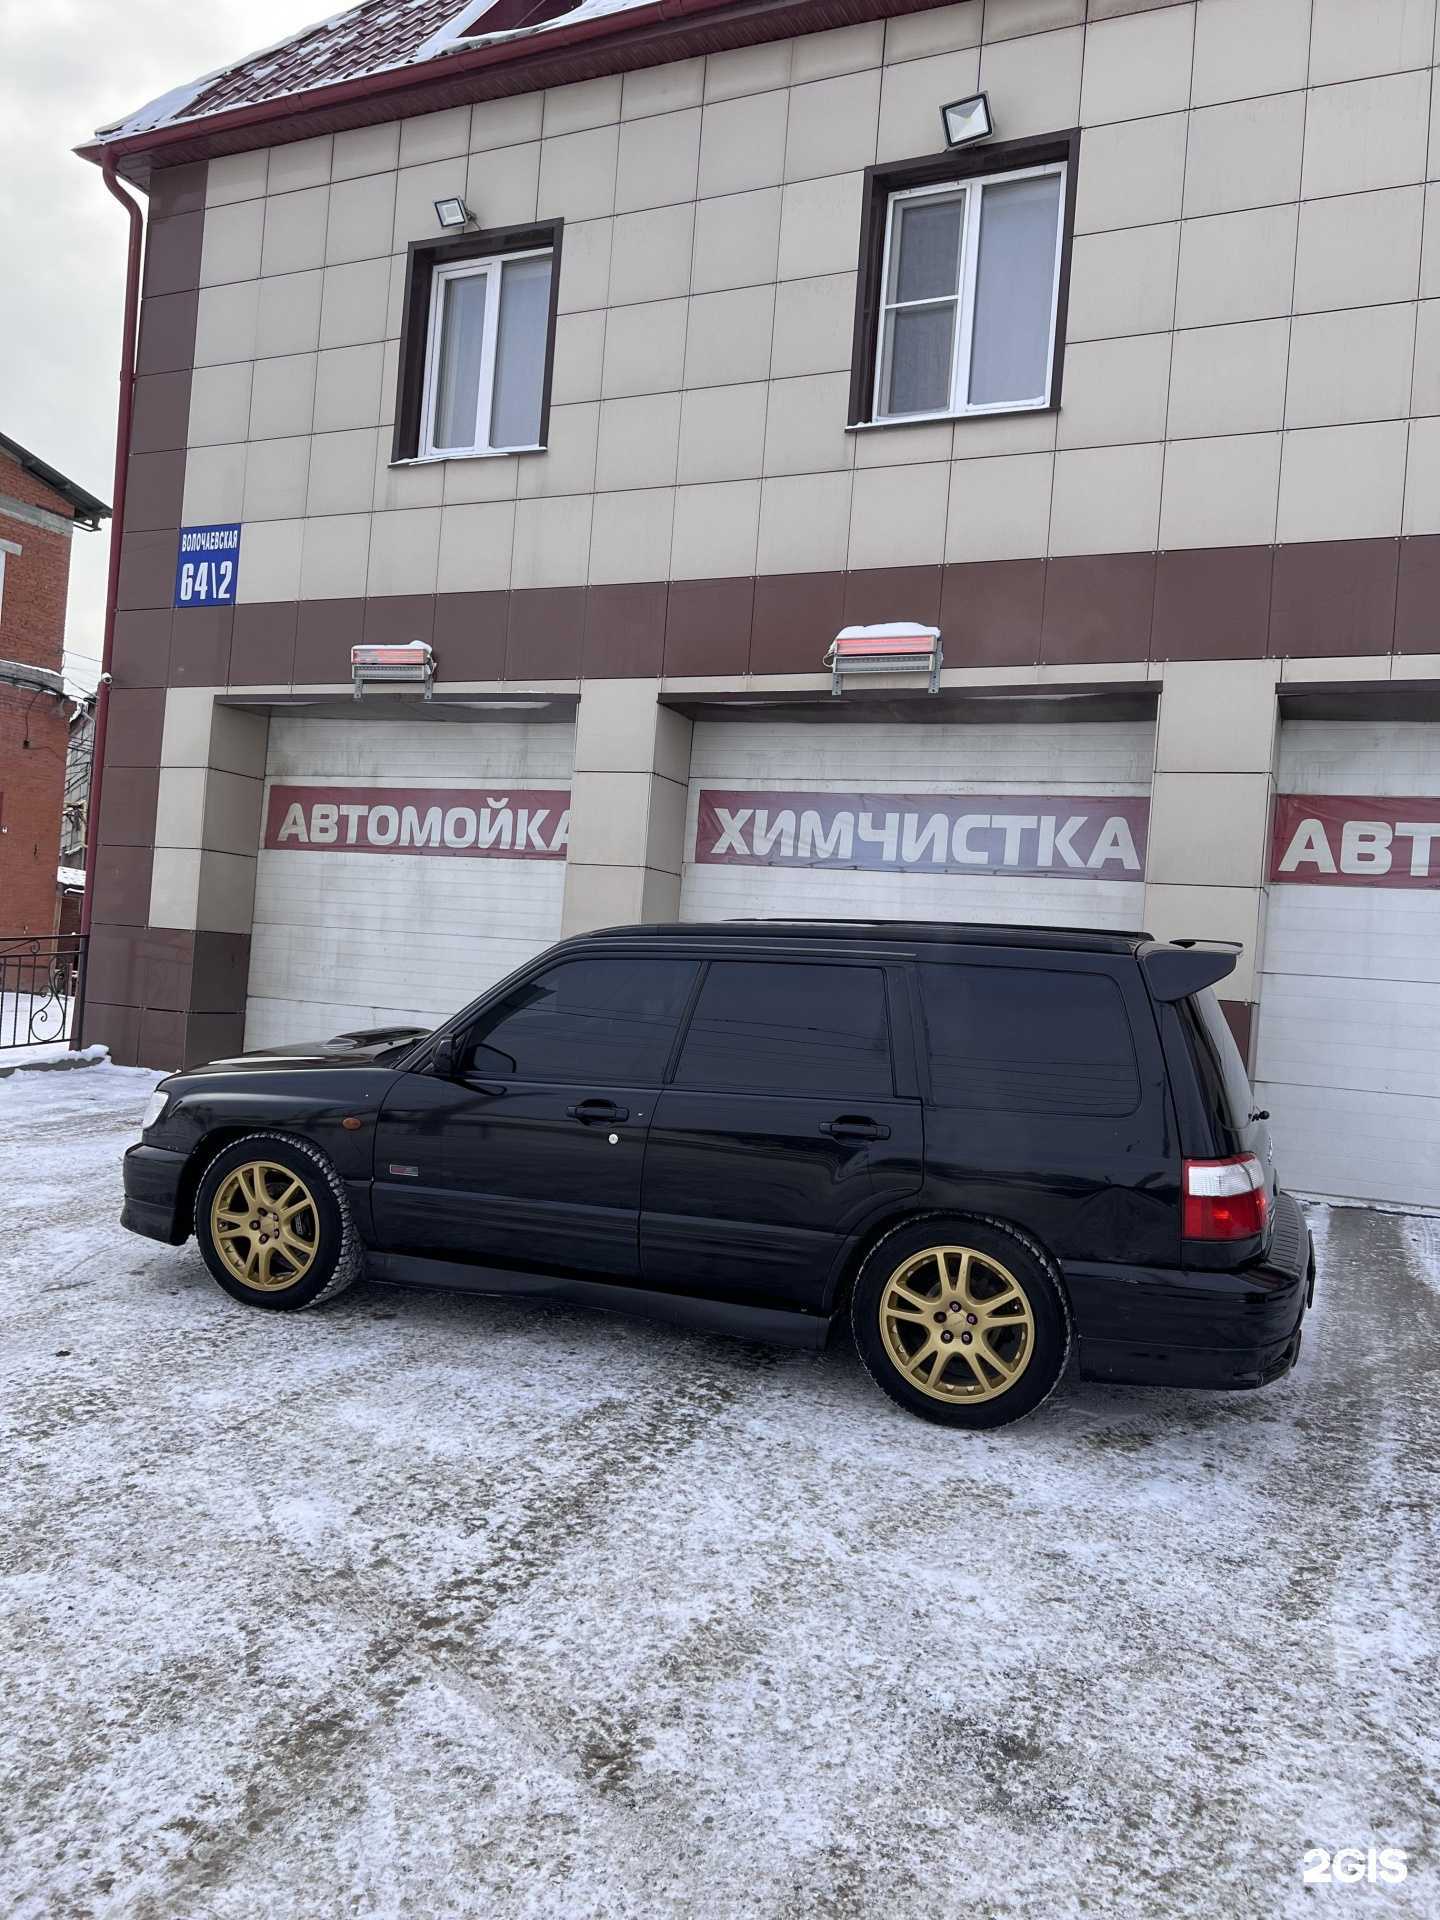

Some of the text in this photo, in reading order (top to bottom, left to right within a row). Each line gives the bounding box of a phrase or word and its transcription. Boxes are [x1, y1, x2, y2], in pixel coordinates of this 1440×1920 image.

[182, 530, 238, 552] ВОЛОЧАЕВСКАЯ
[181, 561, 232, 600] 64\2
[711, 807, 1141, 870] ХИМЧИСТКА
